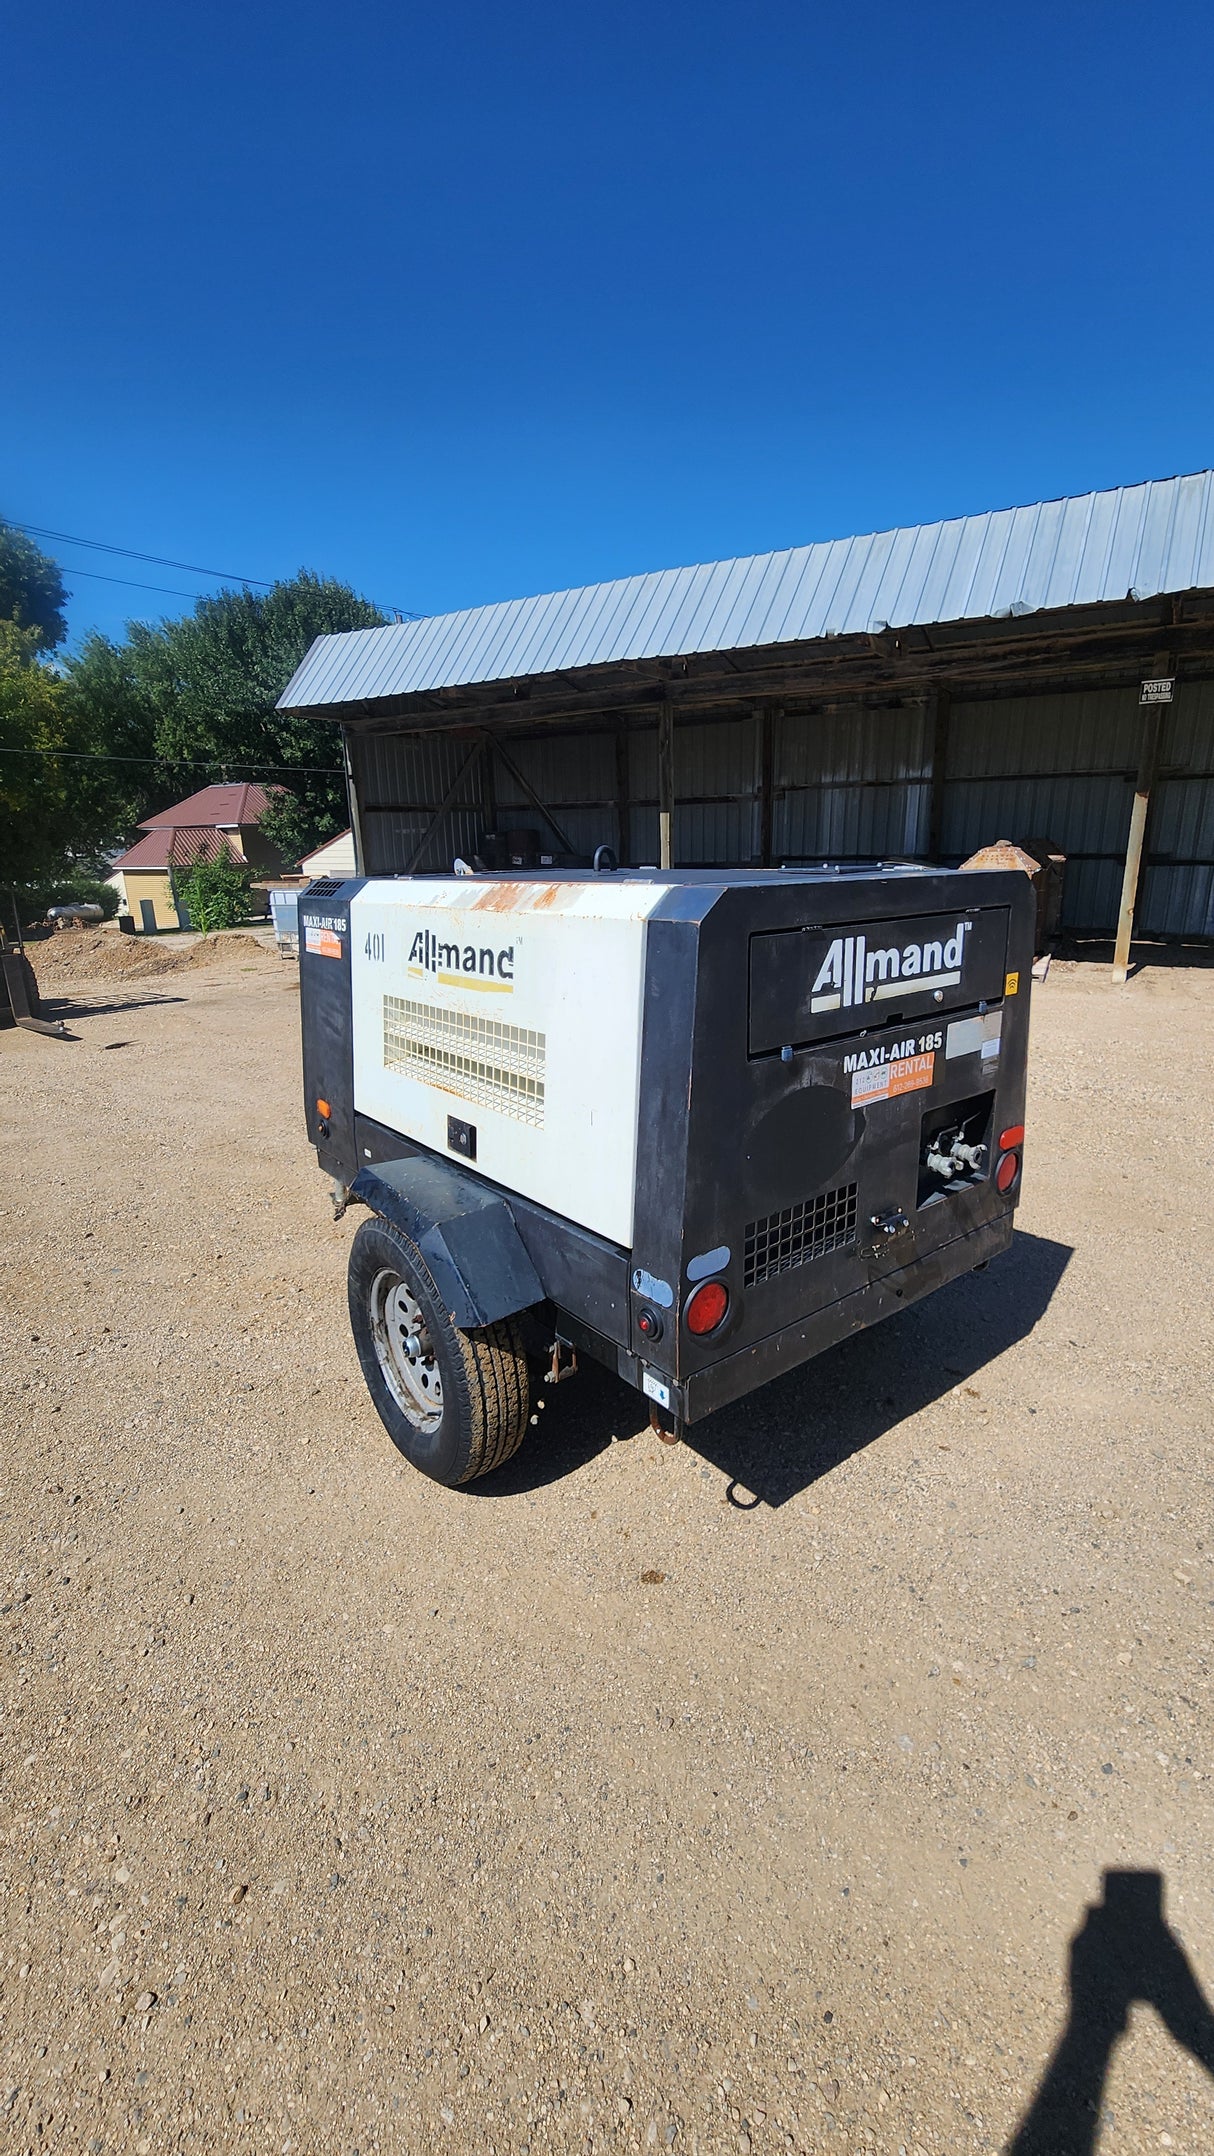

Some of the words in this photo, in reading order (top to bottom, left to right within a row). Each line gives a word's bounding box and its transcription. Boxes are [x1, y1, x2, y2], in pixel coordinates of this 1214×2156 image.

[1143, 682, 1171, 694] POSTED
[303, 915, 333, 930] MAXI-AIR
[334, 917, 347, 932] 185
[408, 929, 514, 980] Allmand
[811, 922, 965, 1007] Allmand
[843, 1039, 916, 1074] MAXI-AIR
[918, 1031, 943, 1053] 185
[890, 1055, 934, 1079] RENTAL
[854, 1079, 887, 1095] EQUIPMENT
